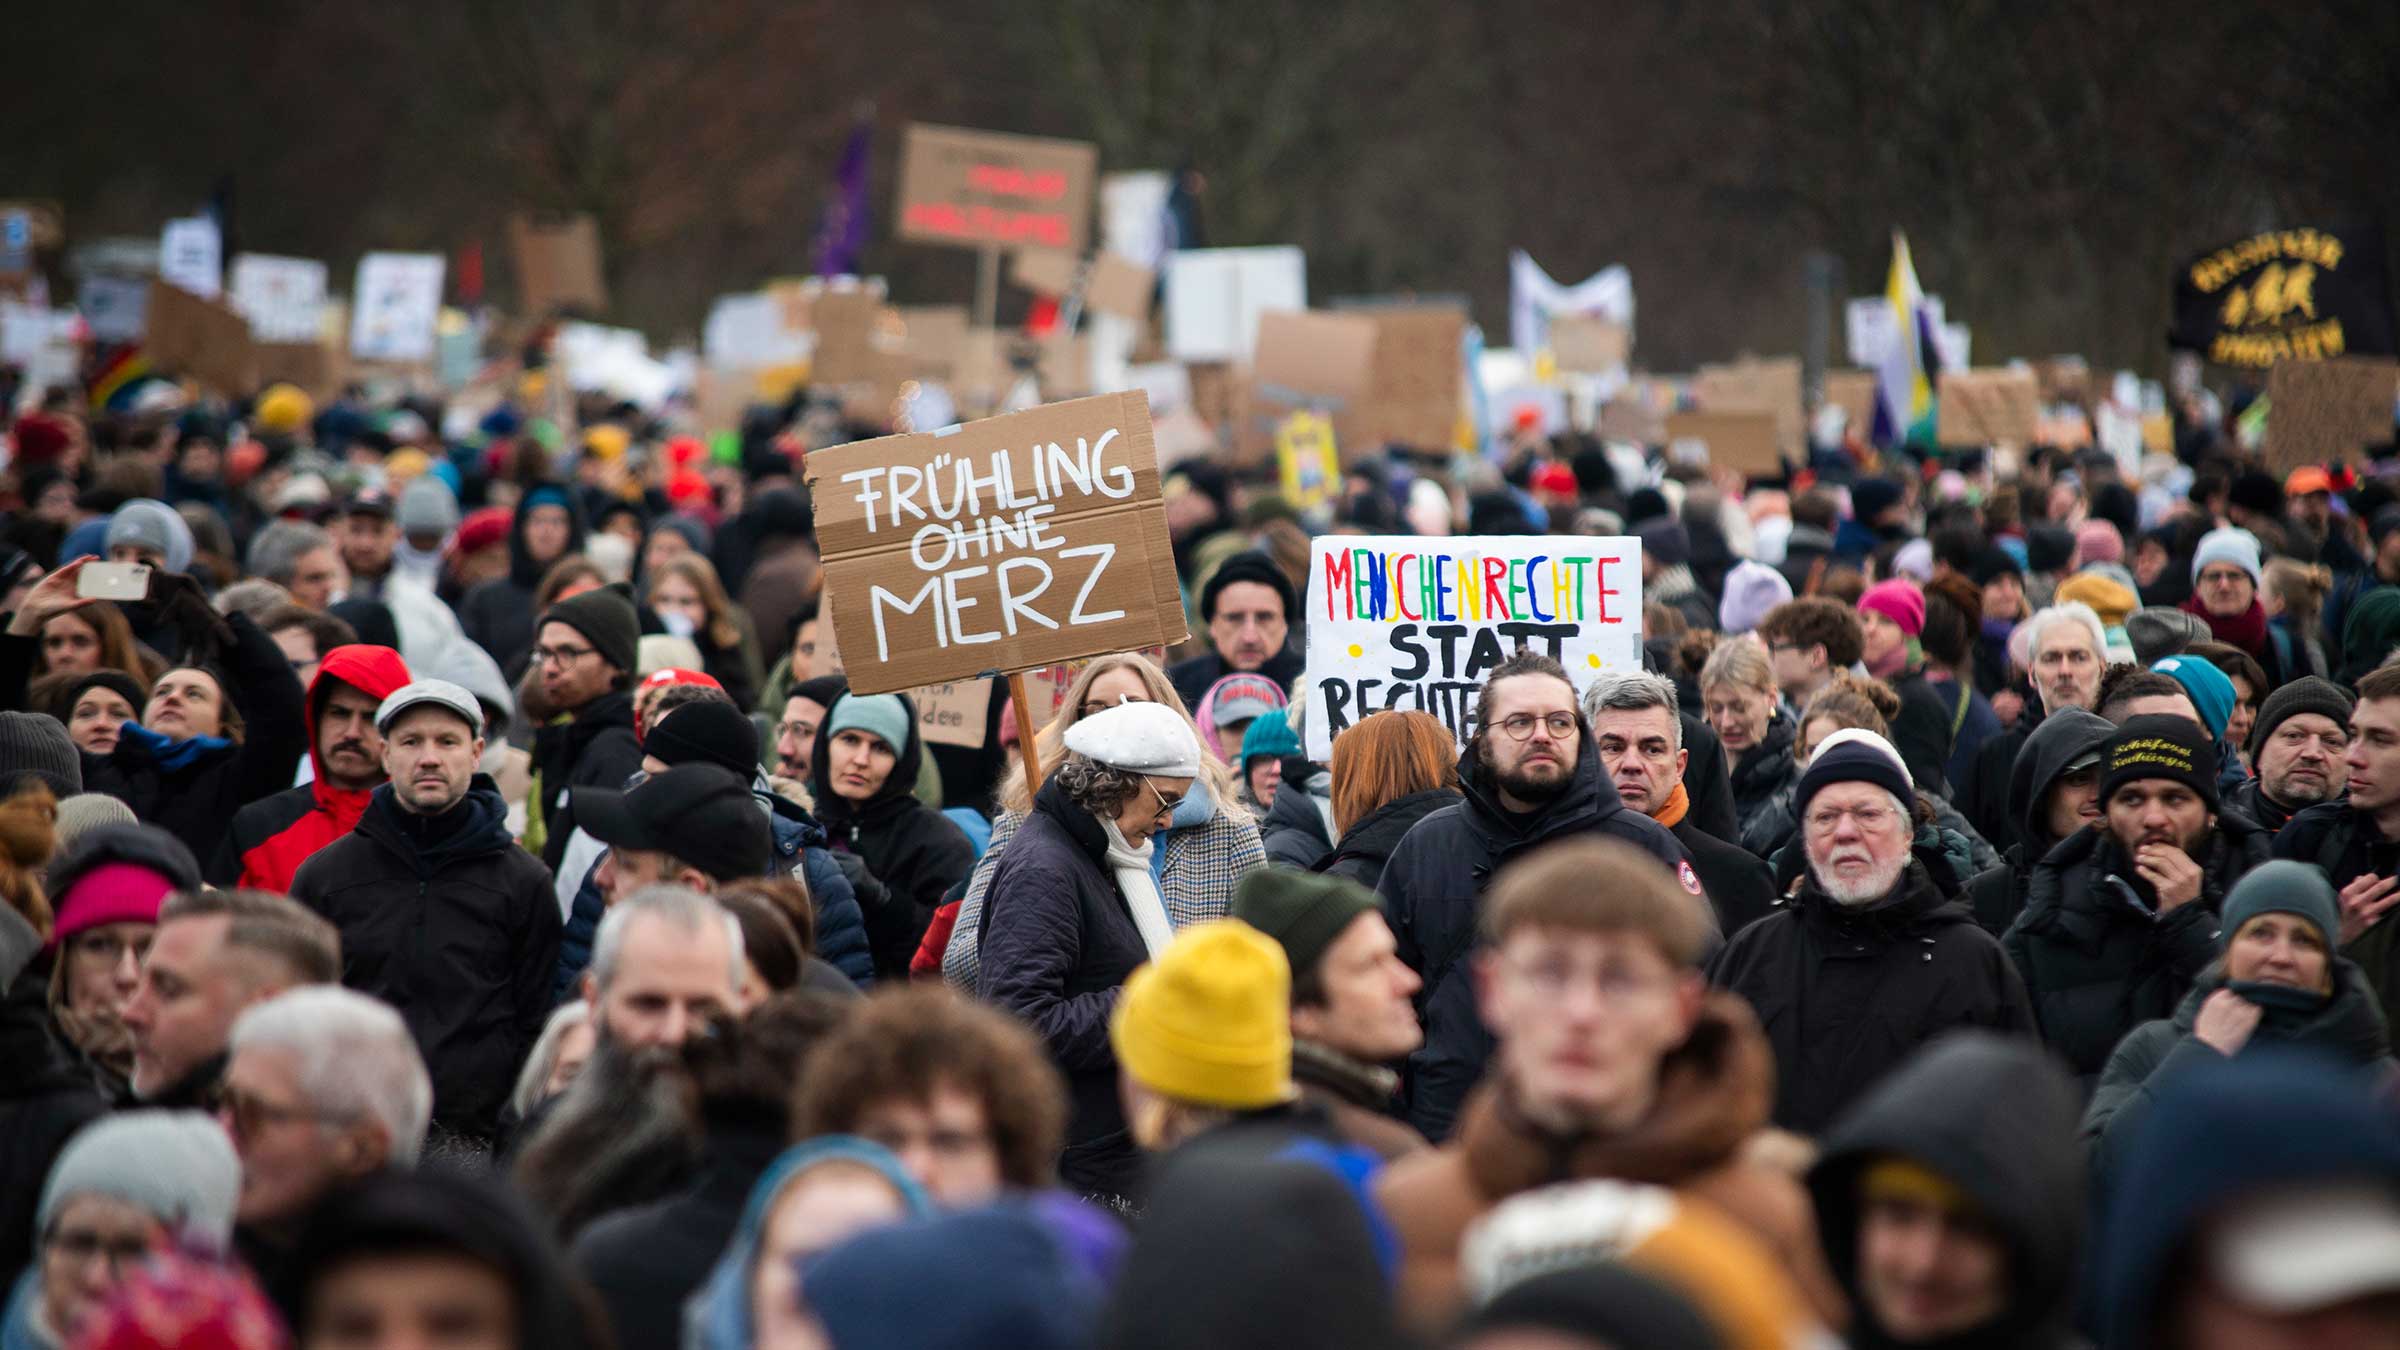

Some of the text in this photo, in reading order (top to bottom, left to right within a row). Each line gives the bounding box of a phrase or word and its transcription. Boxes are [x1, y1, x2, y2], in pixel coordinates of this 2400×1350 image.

[841, 428, 1135, 533] FRÜHLING
[911, 504, 1066, 571] OHNE
[871, 543, 1126, 662] MERZ
[1325, 548, 1622, 623] MENSCHENRECHTE
[1389, 622, 1580, 681] STATT
